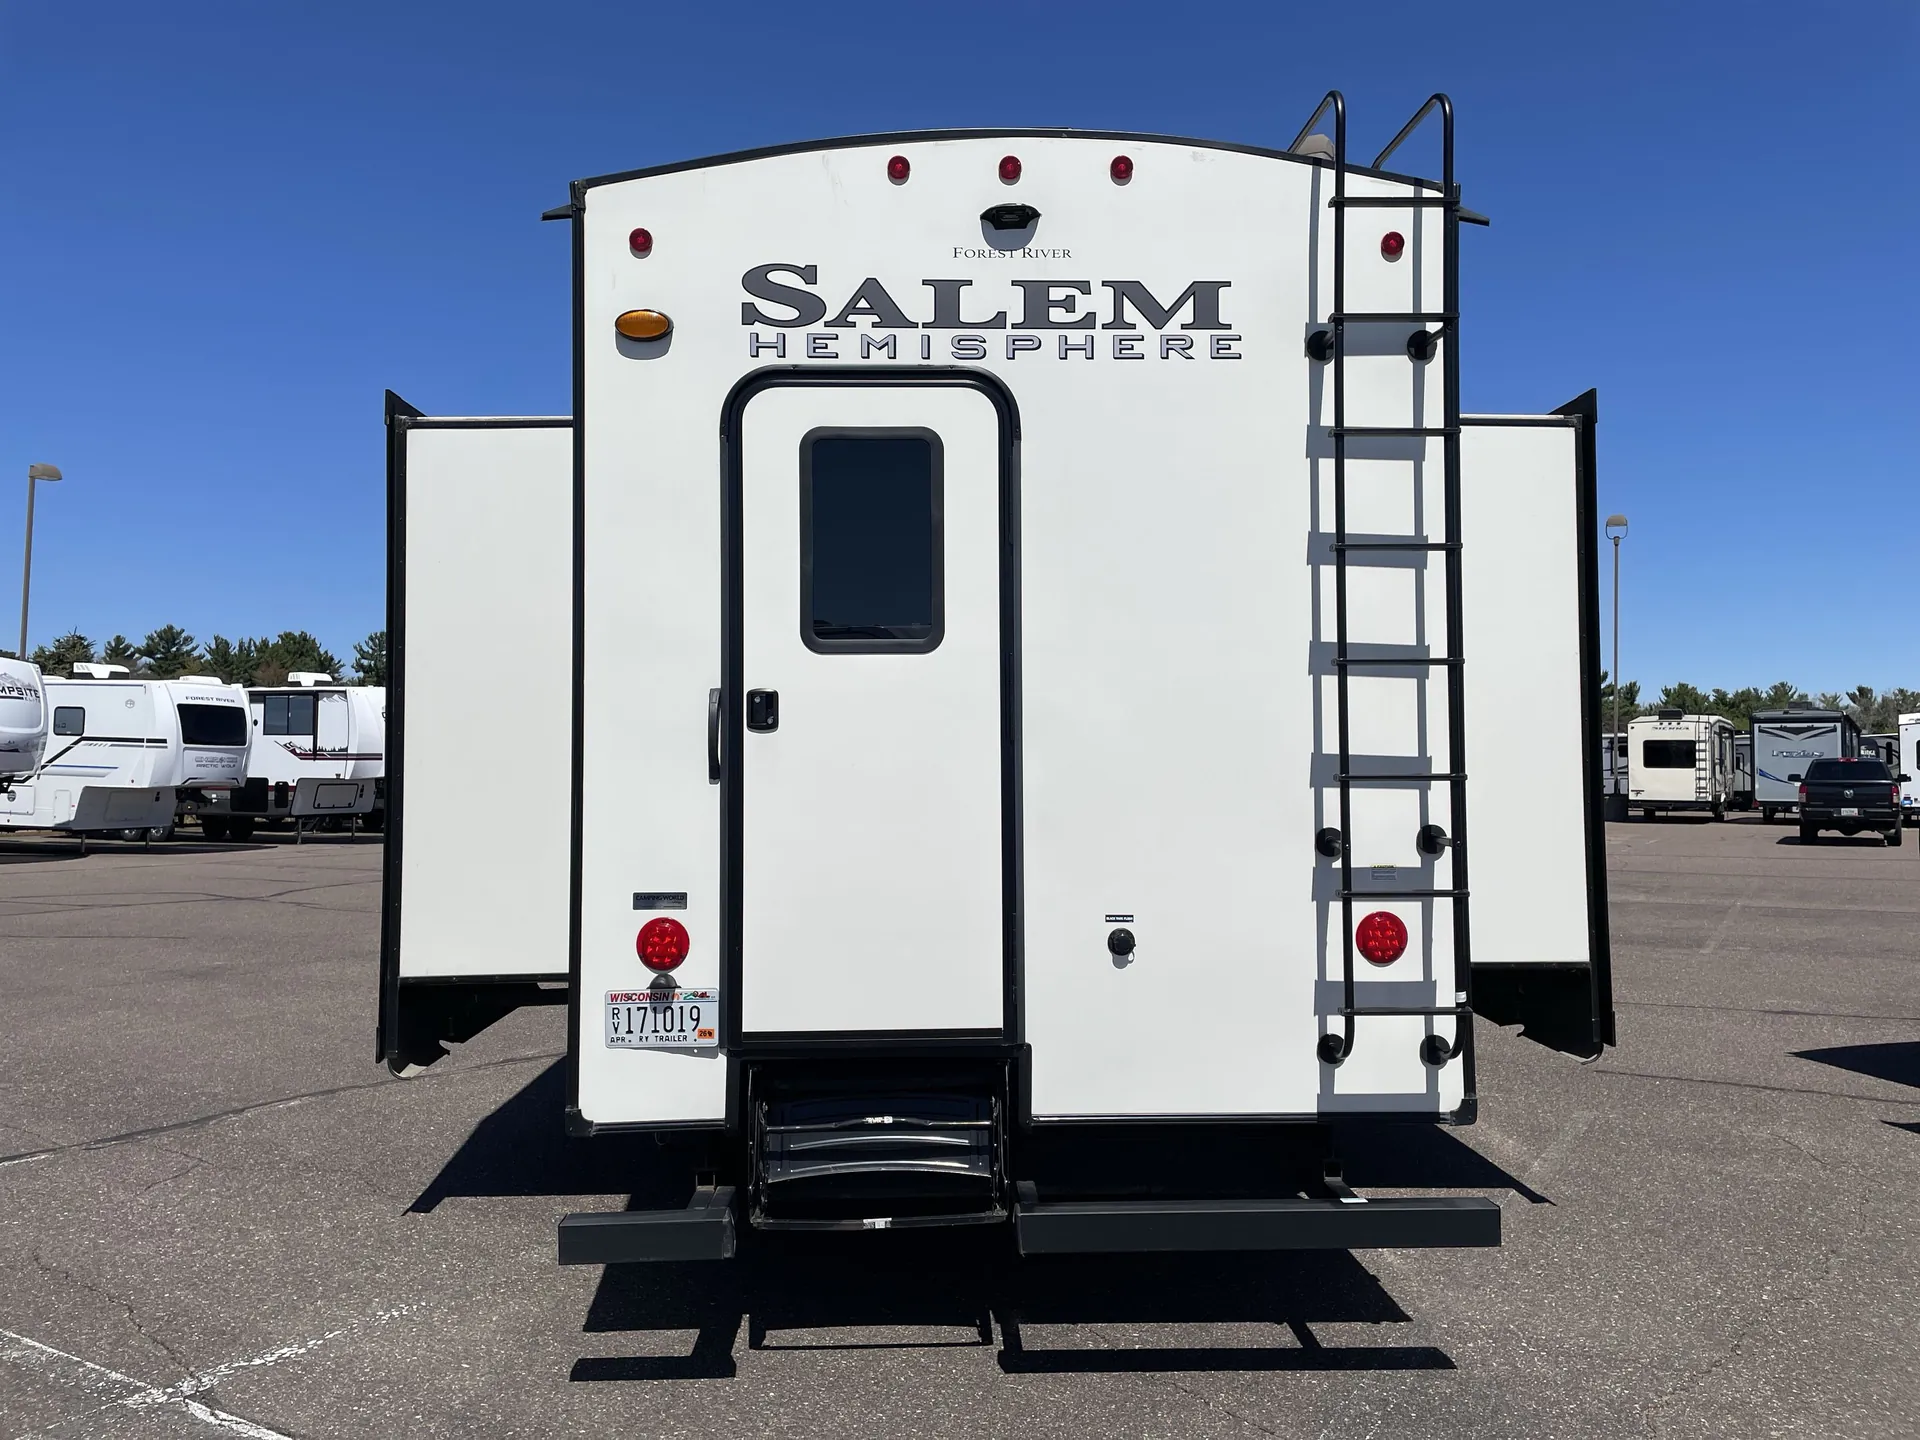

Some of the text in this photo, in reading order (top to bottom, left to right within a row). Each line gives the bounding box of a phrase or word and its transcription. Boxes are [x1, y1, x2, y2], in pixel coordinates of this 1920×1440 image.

[952, 246, 1073, 259] FOREST RIVER
[741, 262, 1232, 330] SALEM
[749, 332, 1242, 361] HEMISPHERE
[610, 992, 670, 1002] WISCONSIN
[625, 1005, 701, 1034] 171019
[655, 1034, 688, 1043] TRAILER
